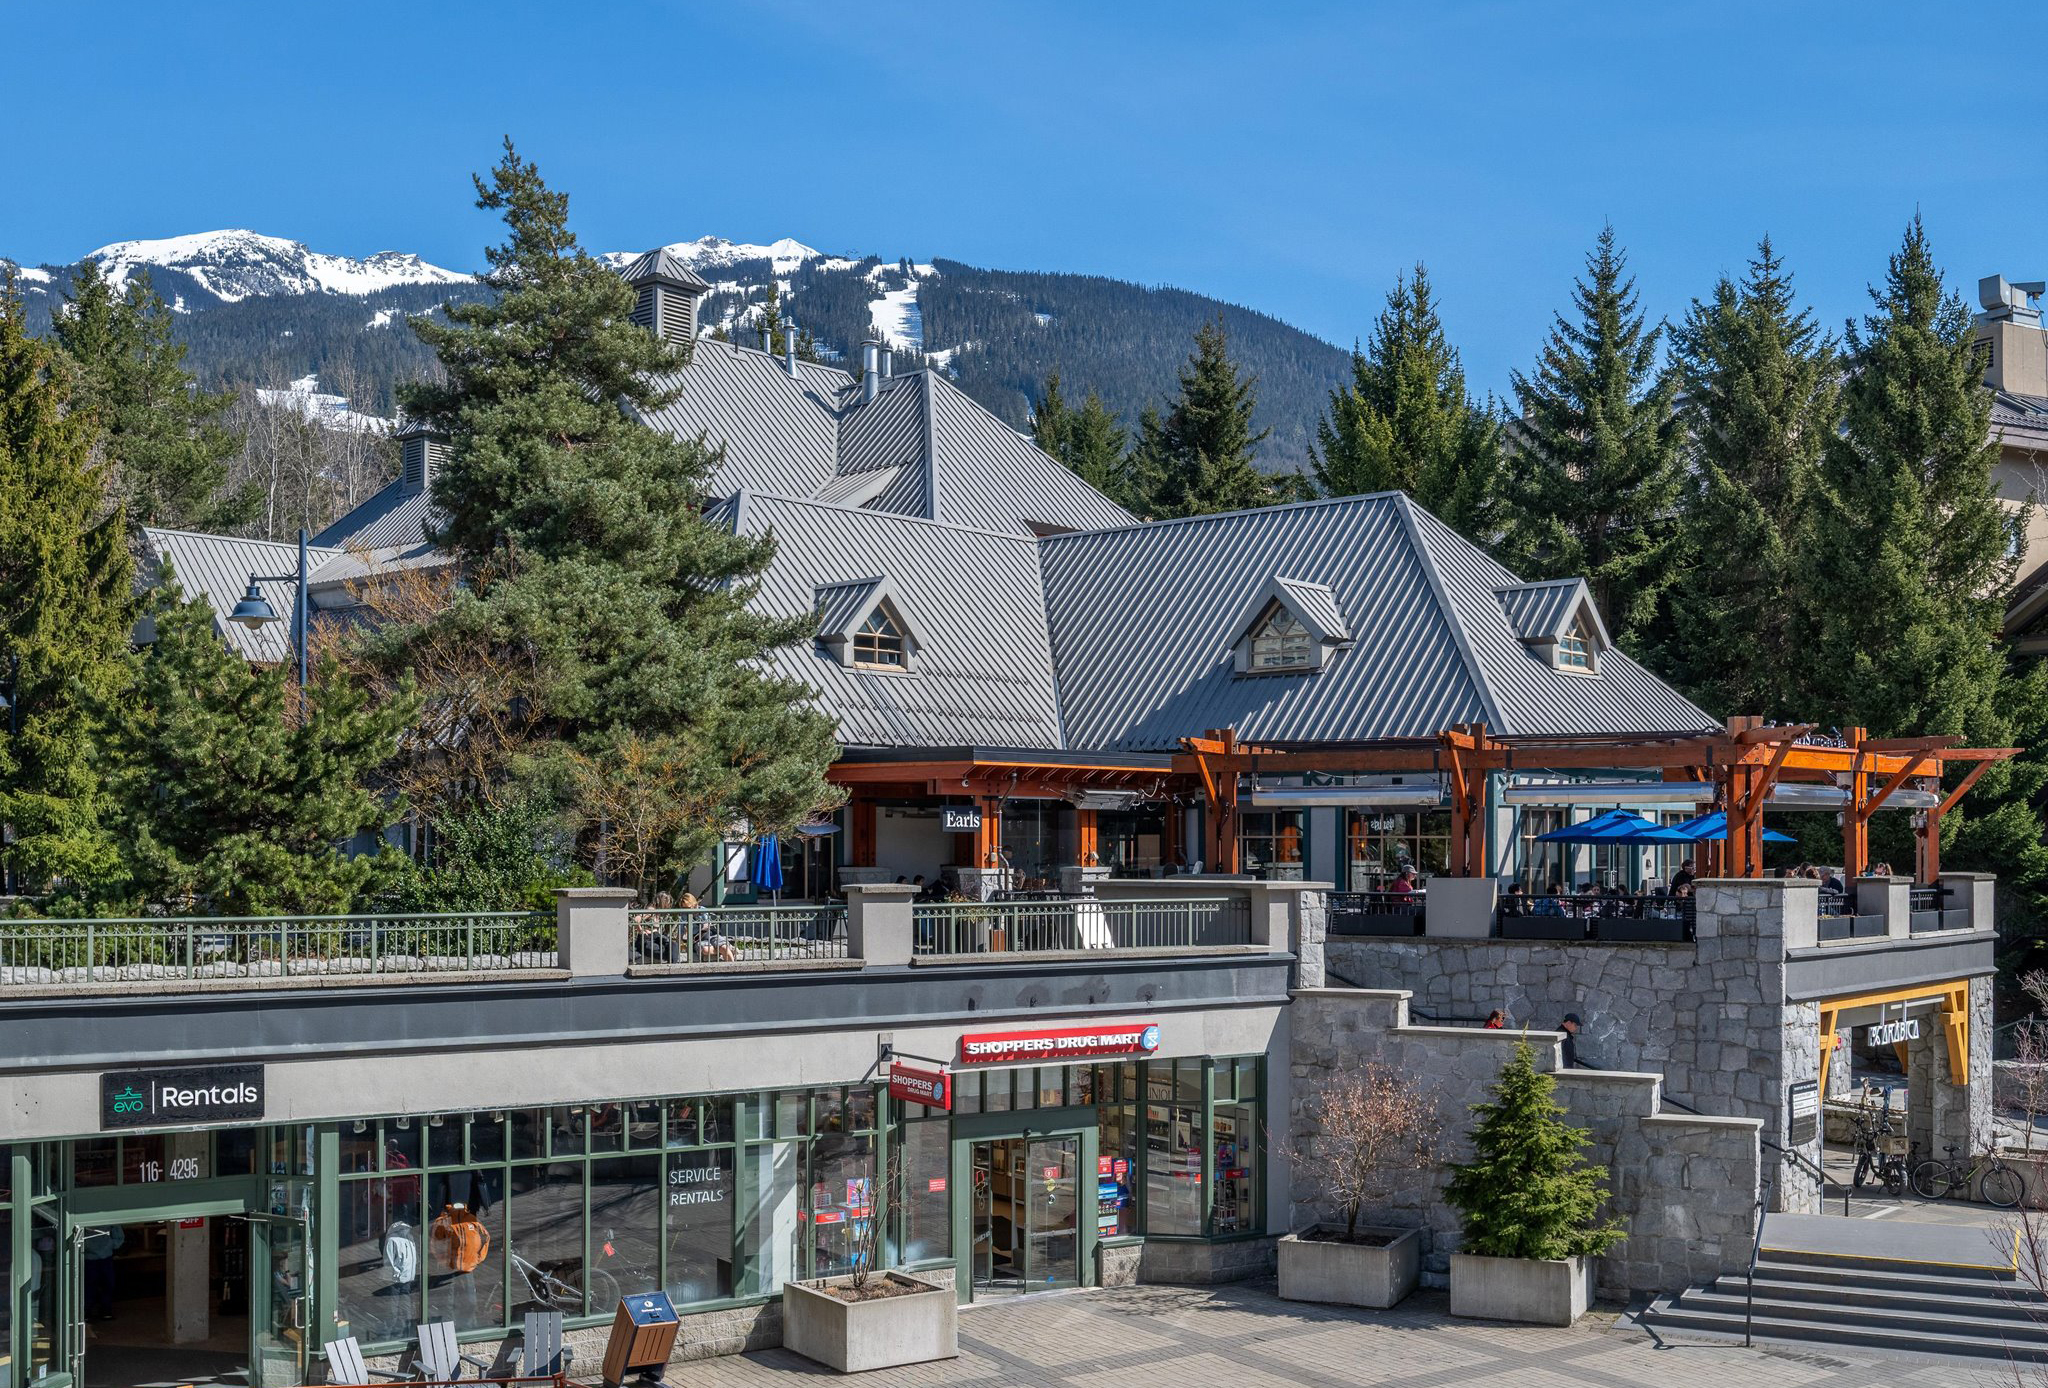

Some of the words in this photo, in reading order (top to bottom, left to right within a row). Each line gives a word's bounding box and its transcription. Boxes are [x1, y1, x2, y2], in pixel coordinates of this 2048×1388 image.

[945, 810, 980, 828] Earls
[966, 1037, 1054, 1055] SHOPPERS
[1056, 1035, 1097, 1049] DRUG
[1098, 1033, 1141, 1046] MART
[892, 1074, 933, 1091] SHOPPERS
[162, 1082, 258, 1108] Rentals
[907, 1086, 920, 1095] DRUG
[919, 1089, 932, 1097] MART
[113, 1099, 144, 1113] evo
[169, 1157, 199, 1181] 4295
[670, 1167, 721, 1184] SERVICE
[670, 1190, 724, 1206] RENTALS
